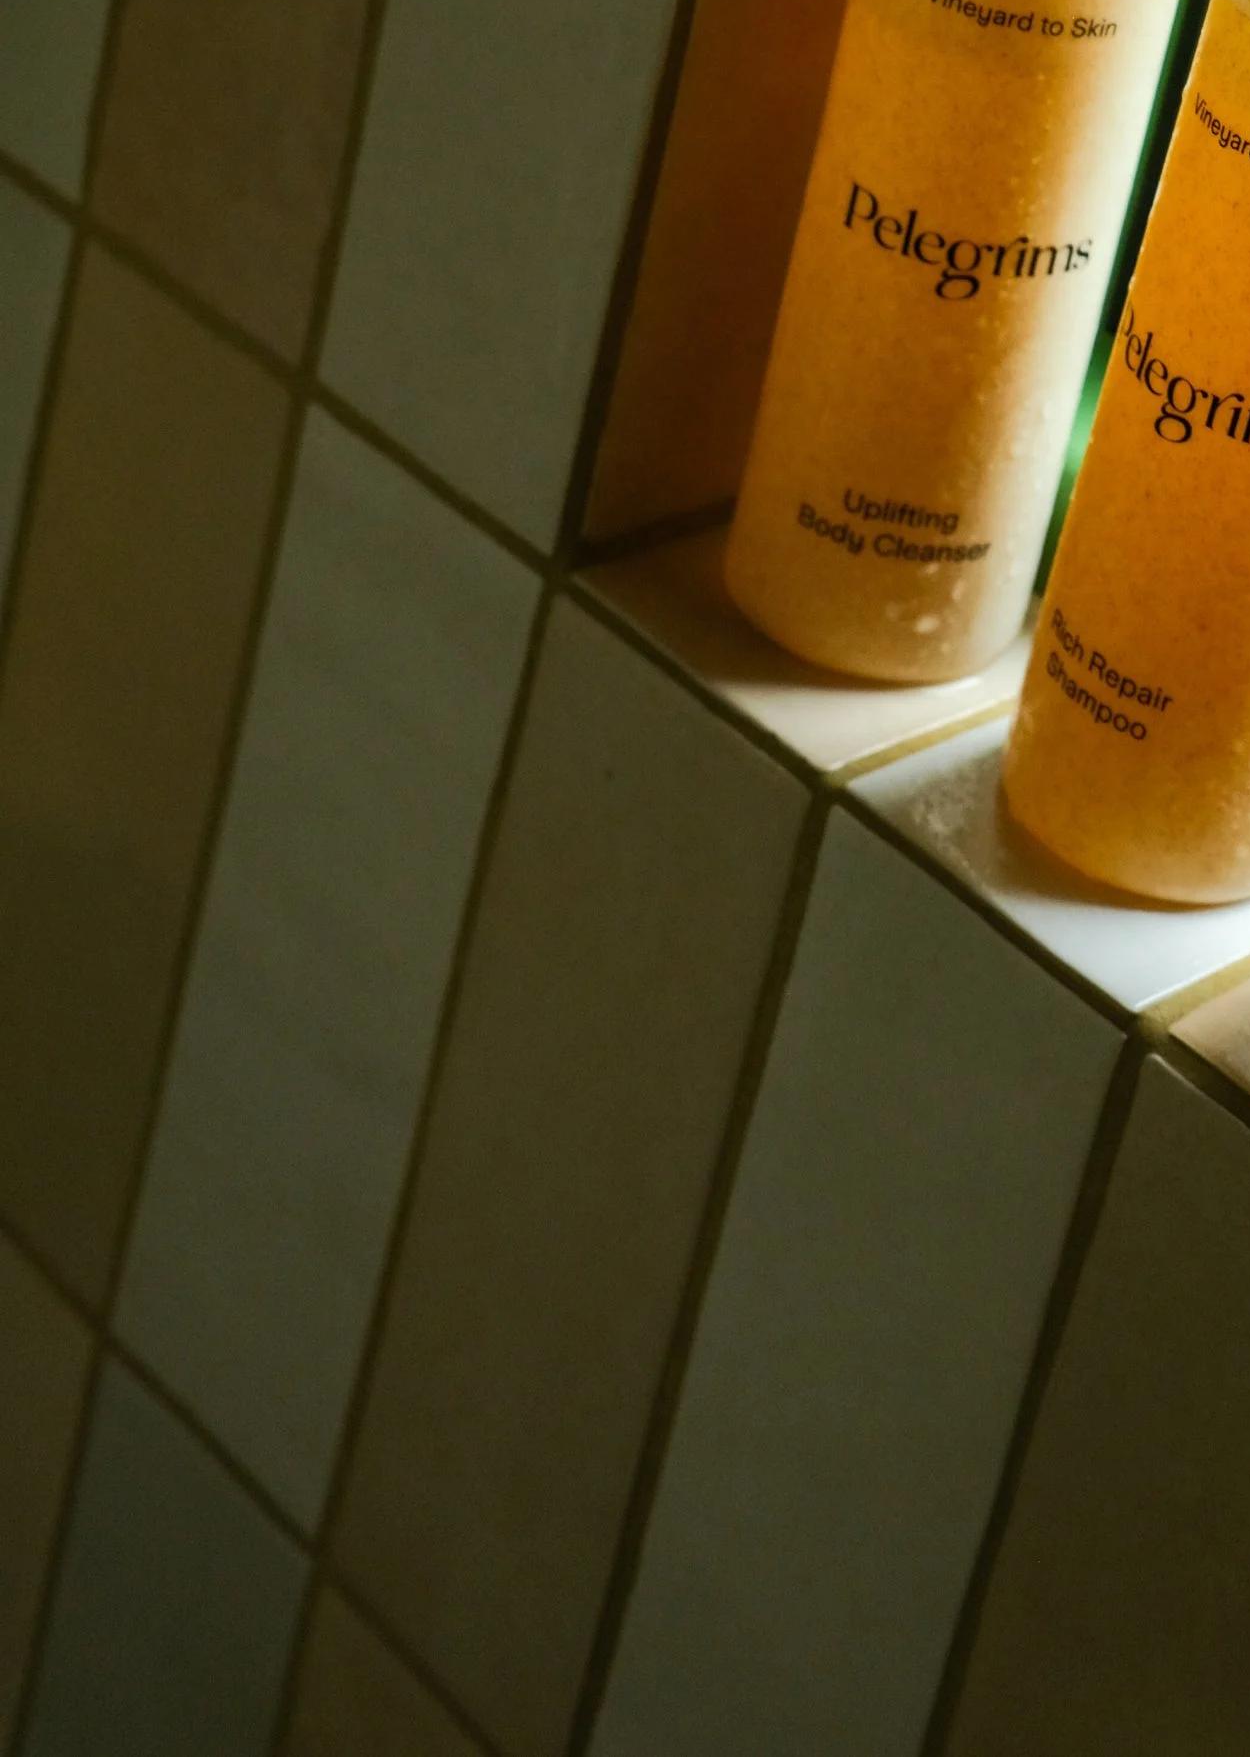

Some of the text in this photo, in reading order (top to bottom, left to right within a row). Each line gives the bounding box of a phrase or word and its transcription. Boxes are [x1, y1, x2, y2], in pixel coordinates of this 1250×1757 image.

[1040, 16, 1064, 37] to
[1070, 18, 1117, 39] Skin
[843, 181, 1093, 301] Pelegrims
[798, 503, 992, 563] Body Cleanser
[843, 487, 960, 535] Uplifting
[1046, 651, 1148, 741] Shampoo
[1088, 650, 1173, 713] Repair
